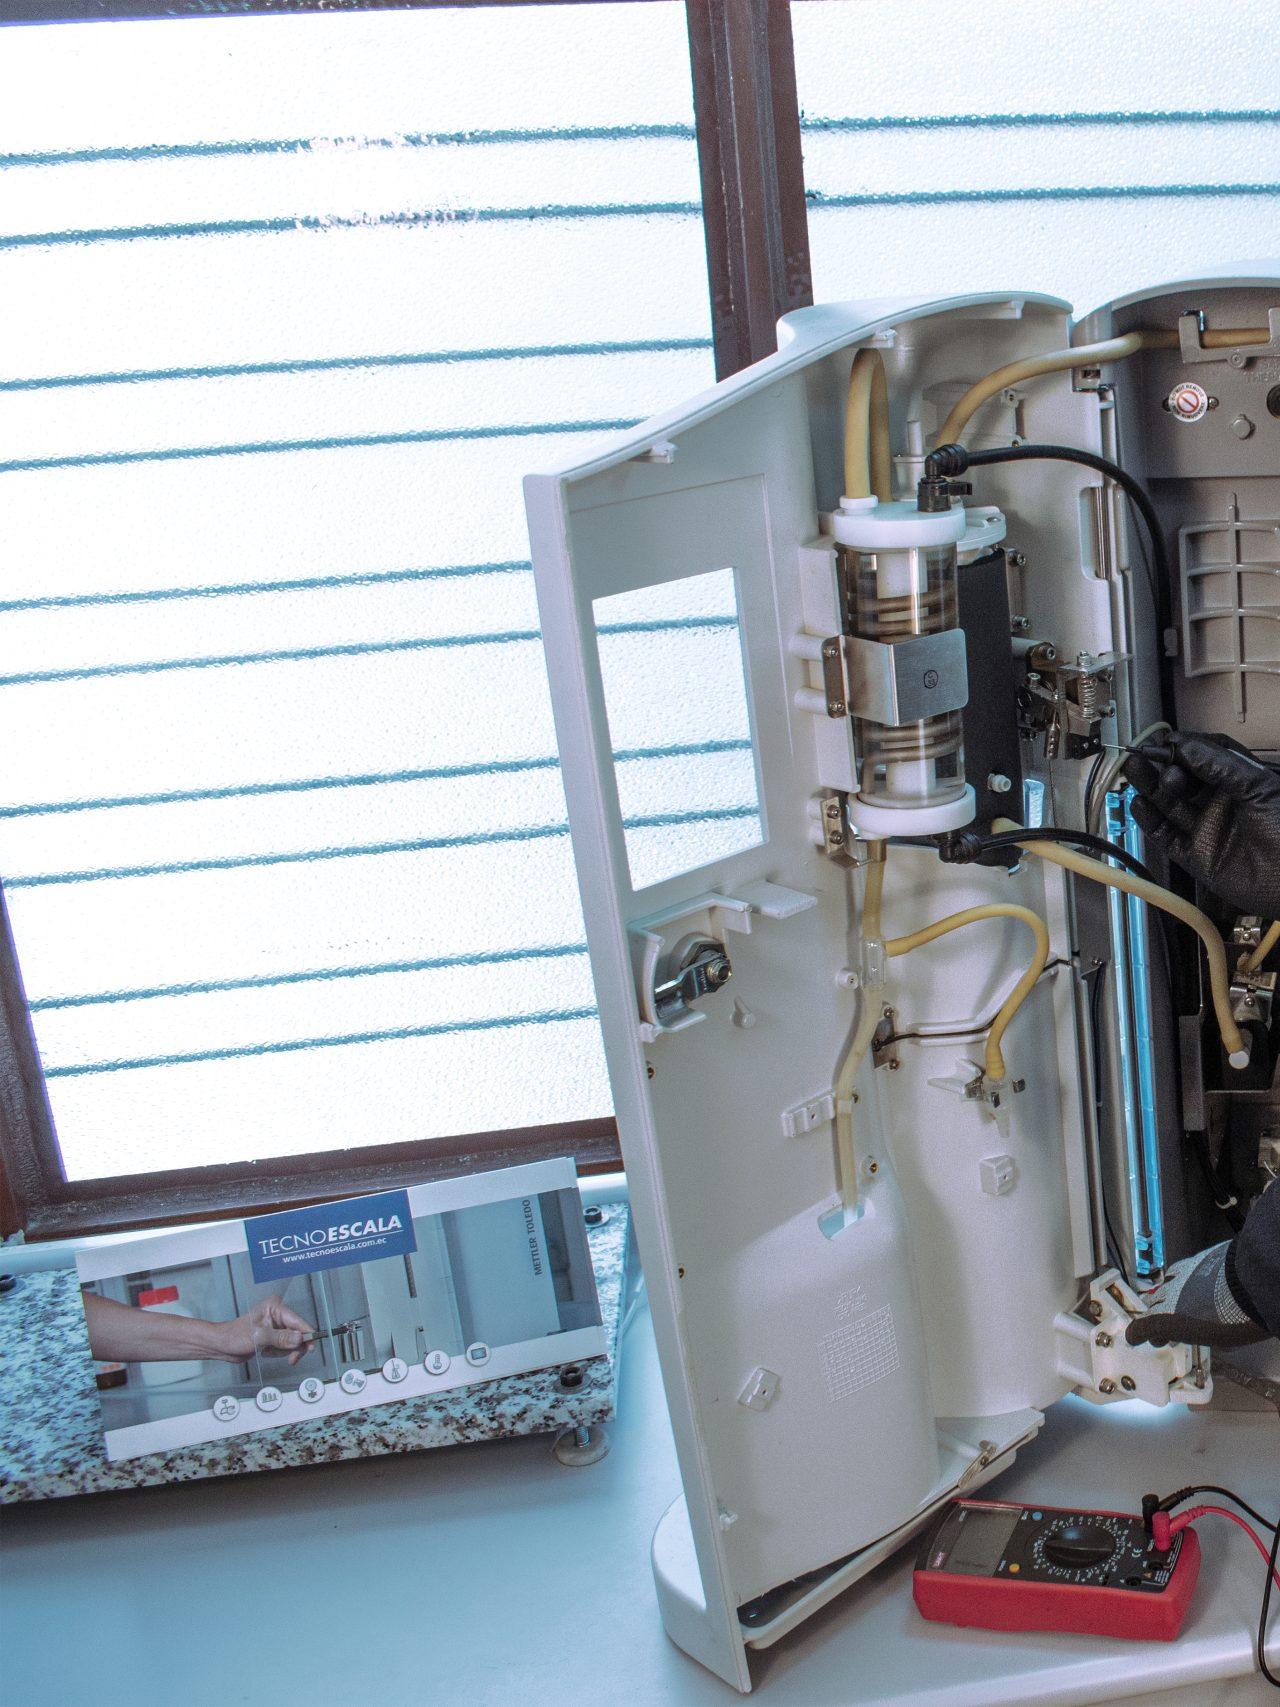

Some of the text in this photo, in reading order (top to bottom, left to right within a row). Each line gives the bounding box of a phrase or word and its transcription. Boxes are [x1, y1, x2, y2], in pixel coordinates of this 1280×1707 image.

[258, 1214, 402, 1255] TECNOESCALA
[282, 1237, 388, 1264] www.tecnoescala.com.ec
[522, 1199, 543, 1276] METTLER TOLEDO
